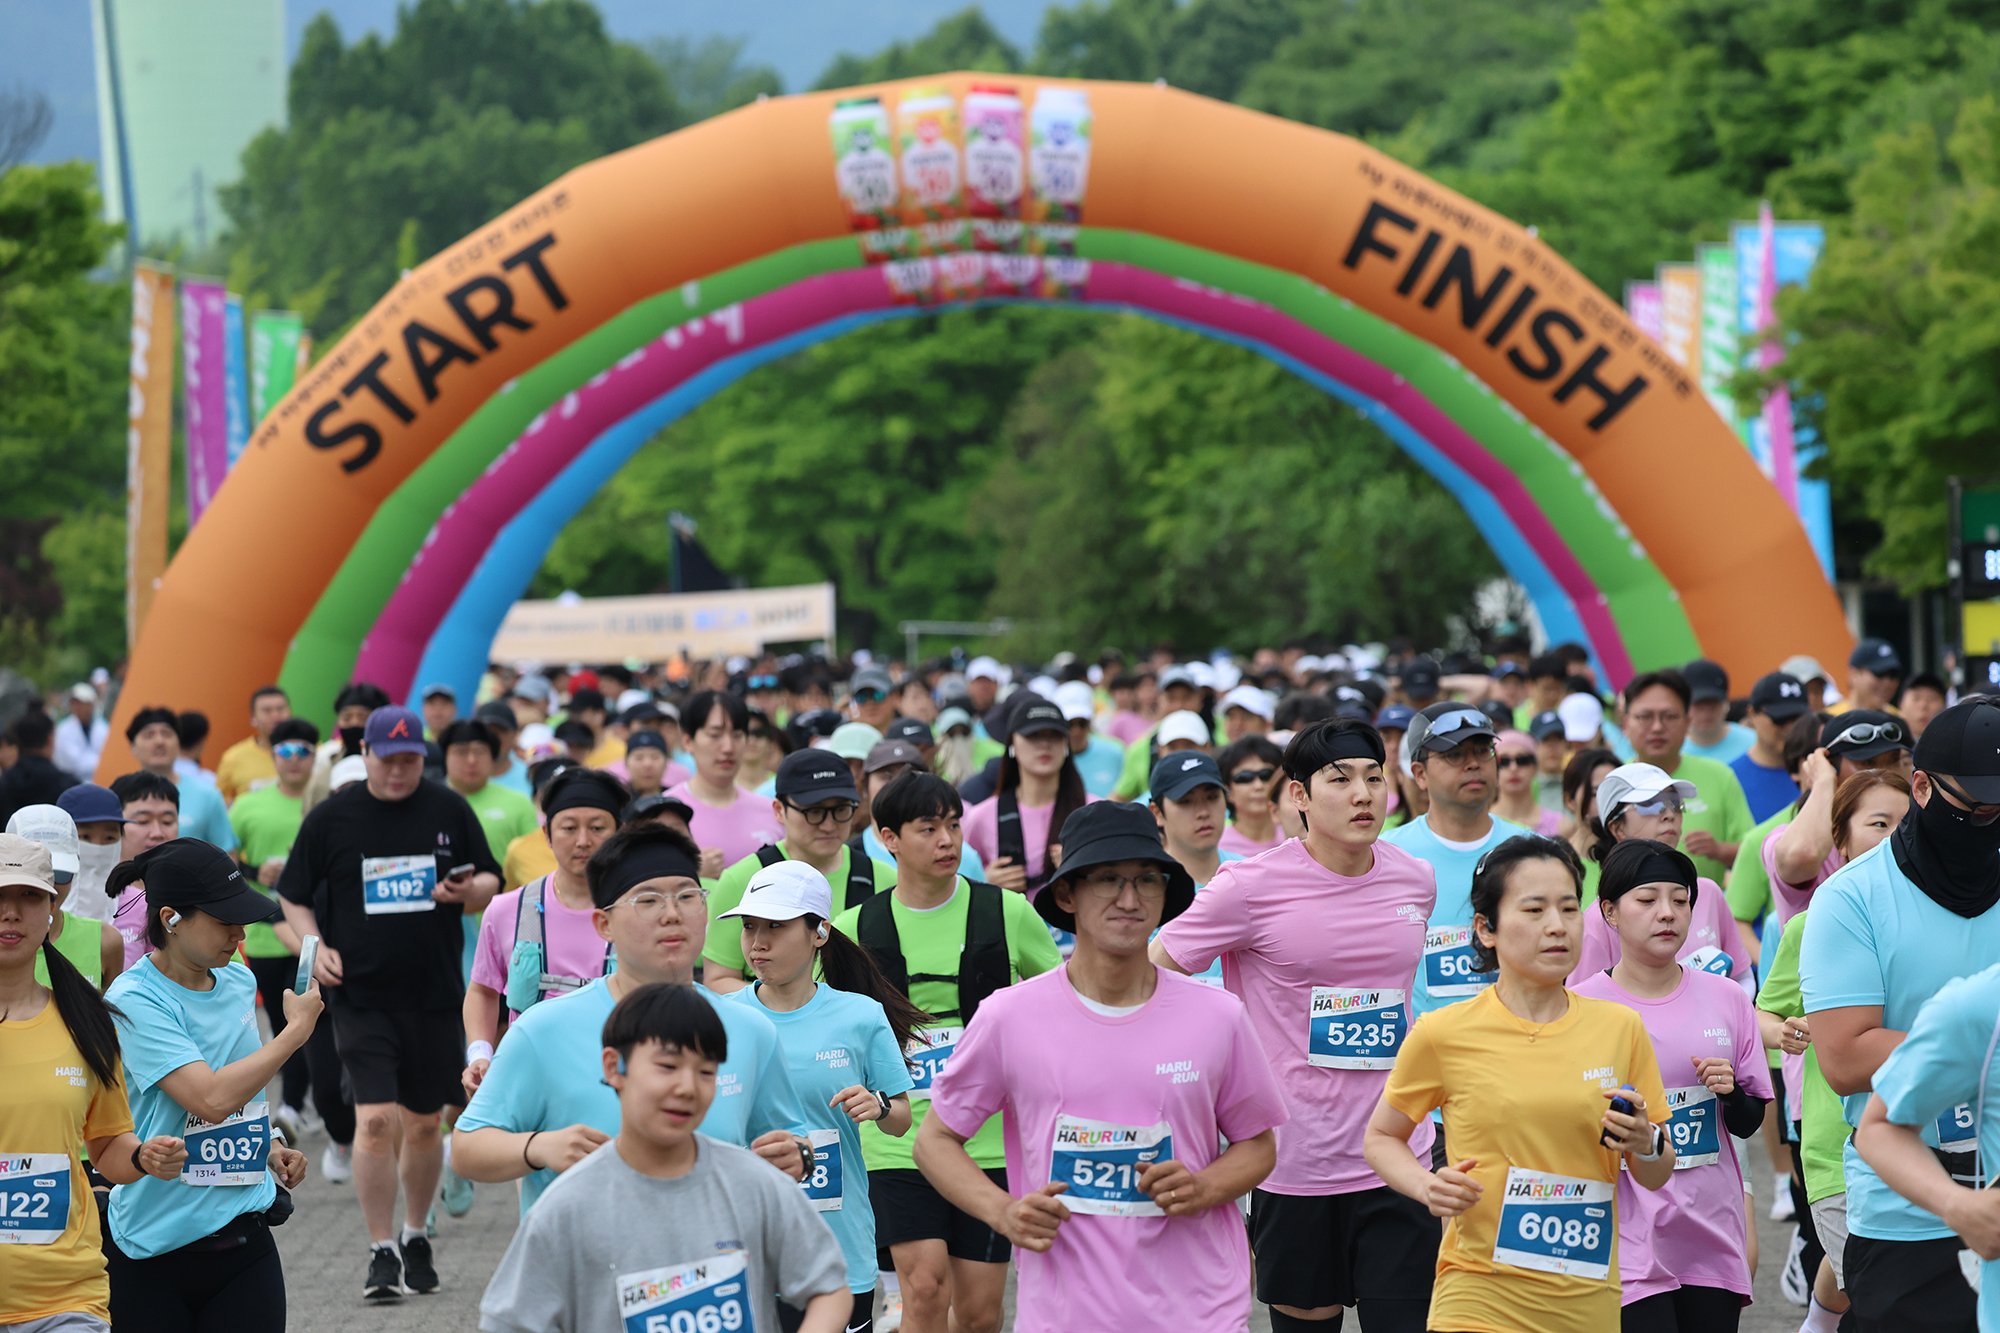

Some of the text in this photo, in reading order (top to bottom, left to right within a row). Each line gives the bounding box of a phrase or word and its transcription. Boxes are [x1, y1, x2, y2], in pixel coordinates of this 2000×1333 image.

[1344, 200, 1648, 432] FINISH
[304, 232, 568, 475] START
[1313, 992, 1380, 1011] HARURUN
[1328, 1022, 1396, 1046] 5235
[1704, 1028, 1727, 1038] HARU
[816, 1049, 845, 1061] HARU
[830, 1058, 850, 1069] RUN
[1156, 1060, 1192, 1075] HARU
[56, 1067, 82, 1077] HARU
[1172, 1070, 1200, 1084] RUN
[1583, 1066, 1614, 1081] HARU
[70, 1076, 87, 1088] RUN
[716, 1074, 736, 1086] ARU
[1600, 1078, 1618, 1089] RUN
[722, 1084, 742, 1096] RUN
[1057, 1130, 1137, 1144] HARURUN
[200, 1137, 263, 1162] 6037
[195, 1170, 216, 1178] 1314
[1508, 1184, 1587, 1197] HARURUN
[1518, 1212, 1600, 1250] 6088
[624, 1265, 706, 1307] HARURUN
[646, 1299, 743, 1333] 5069
